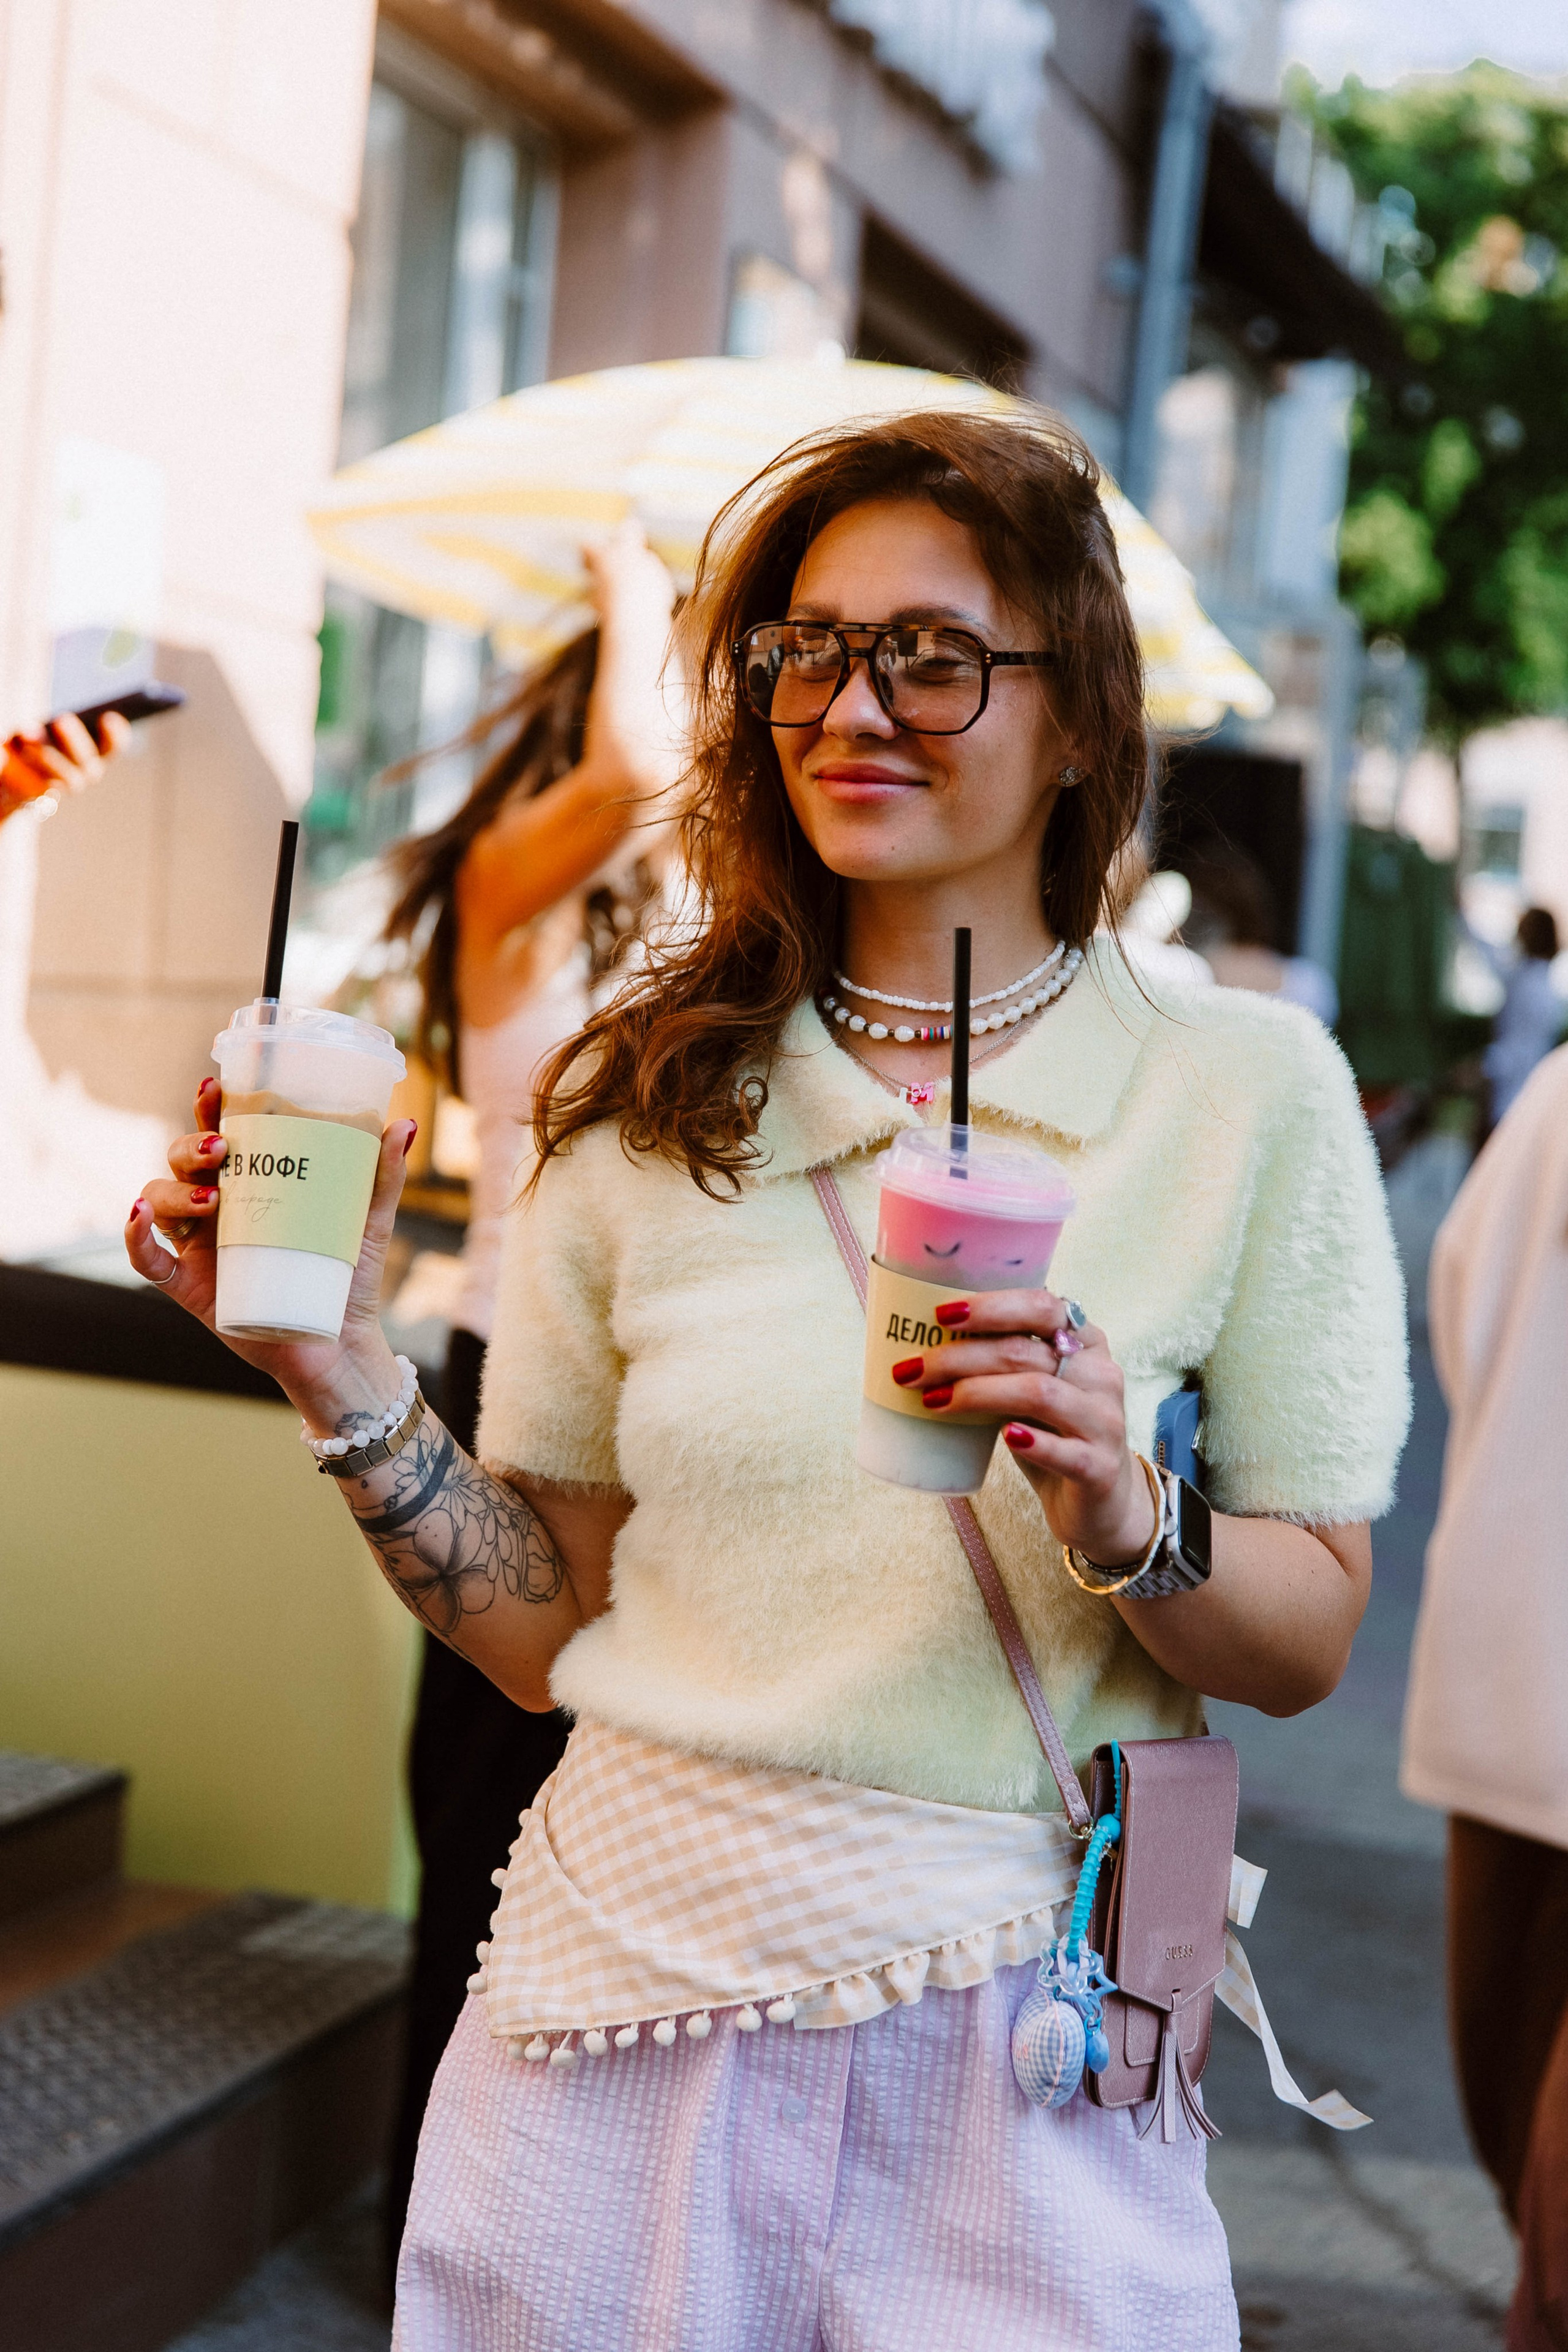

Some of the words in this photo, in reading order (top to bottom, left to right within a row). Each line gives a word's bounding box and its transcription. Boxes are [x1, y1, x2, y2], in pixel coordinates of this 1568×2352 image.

[235, 1153, 243, 1176] В
[249, 1153, 309, 1180] КОФЕ
[886, 1313, 943, 1348] ДЕЛО
[1165, 1944, 1193, 1960] GUESS
